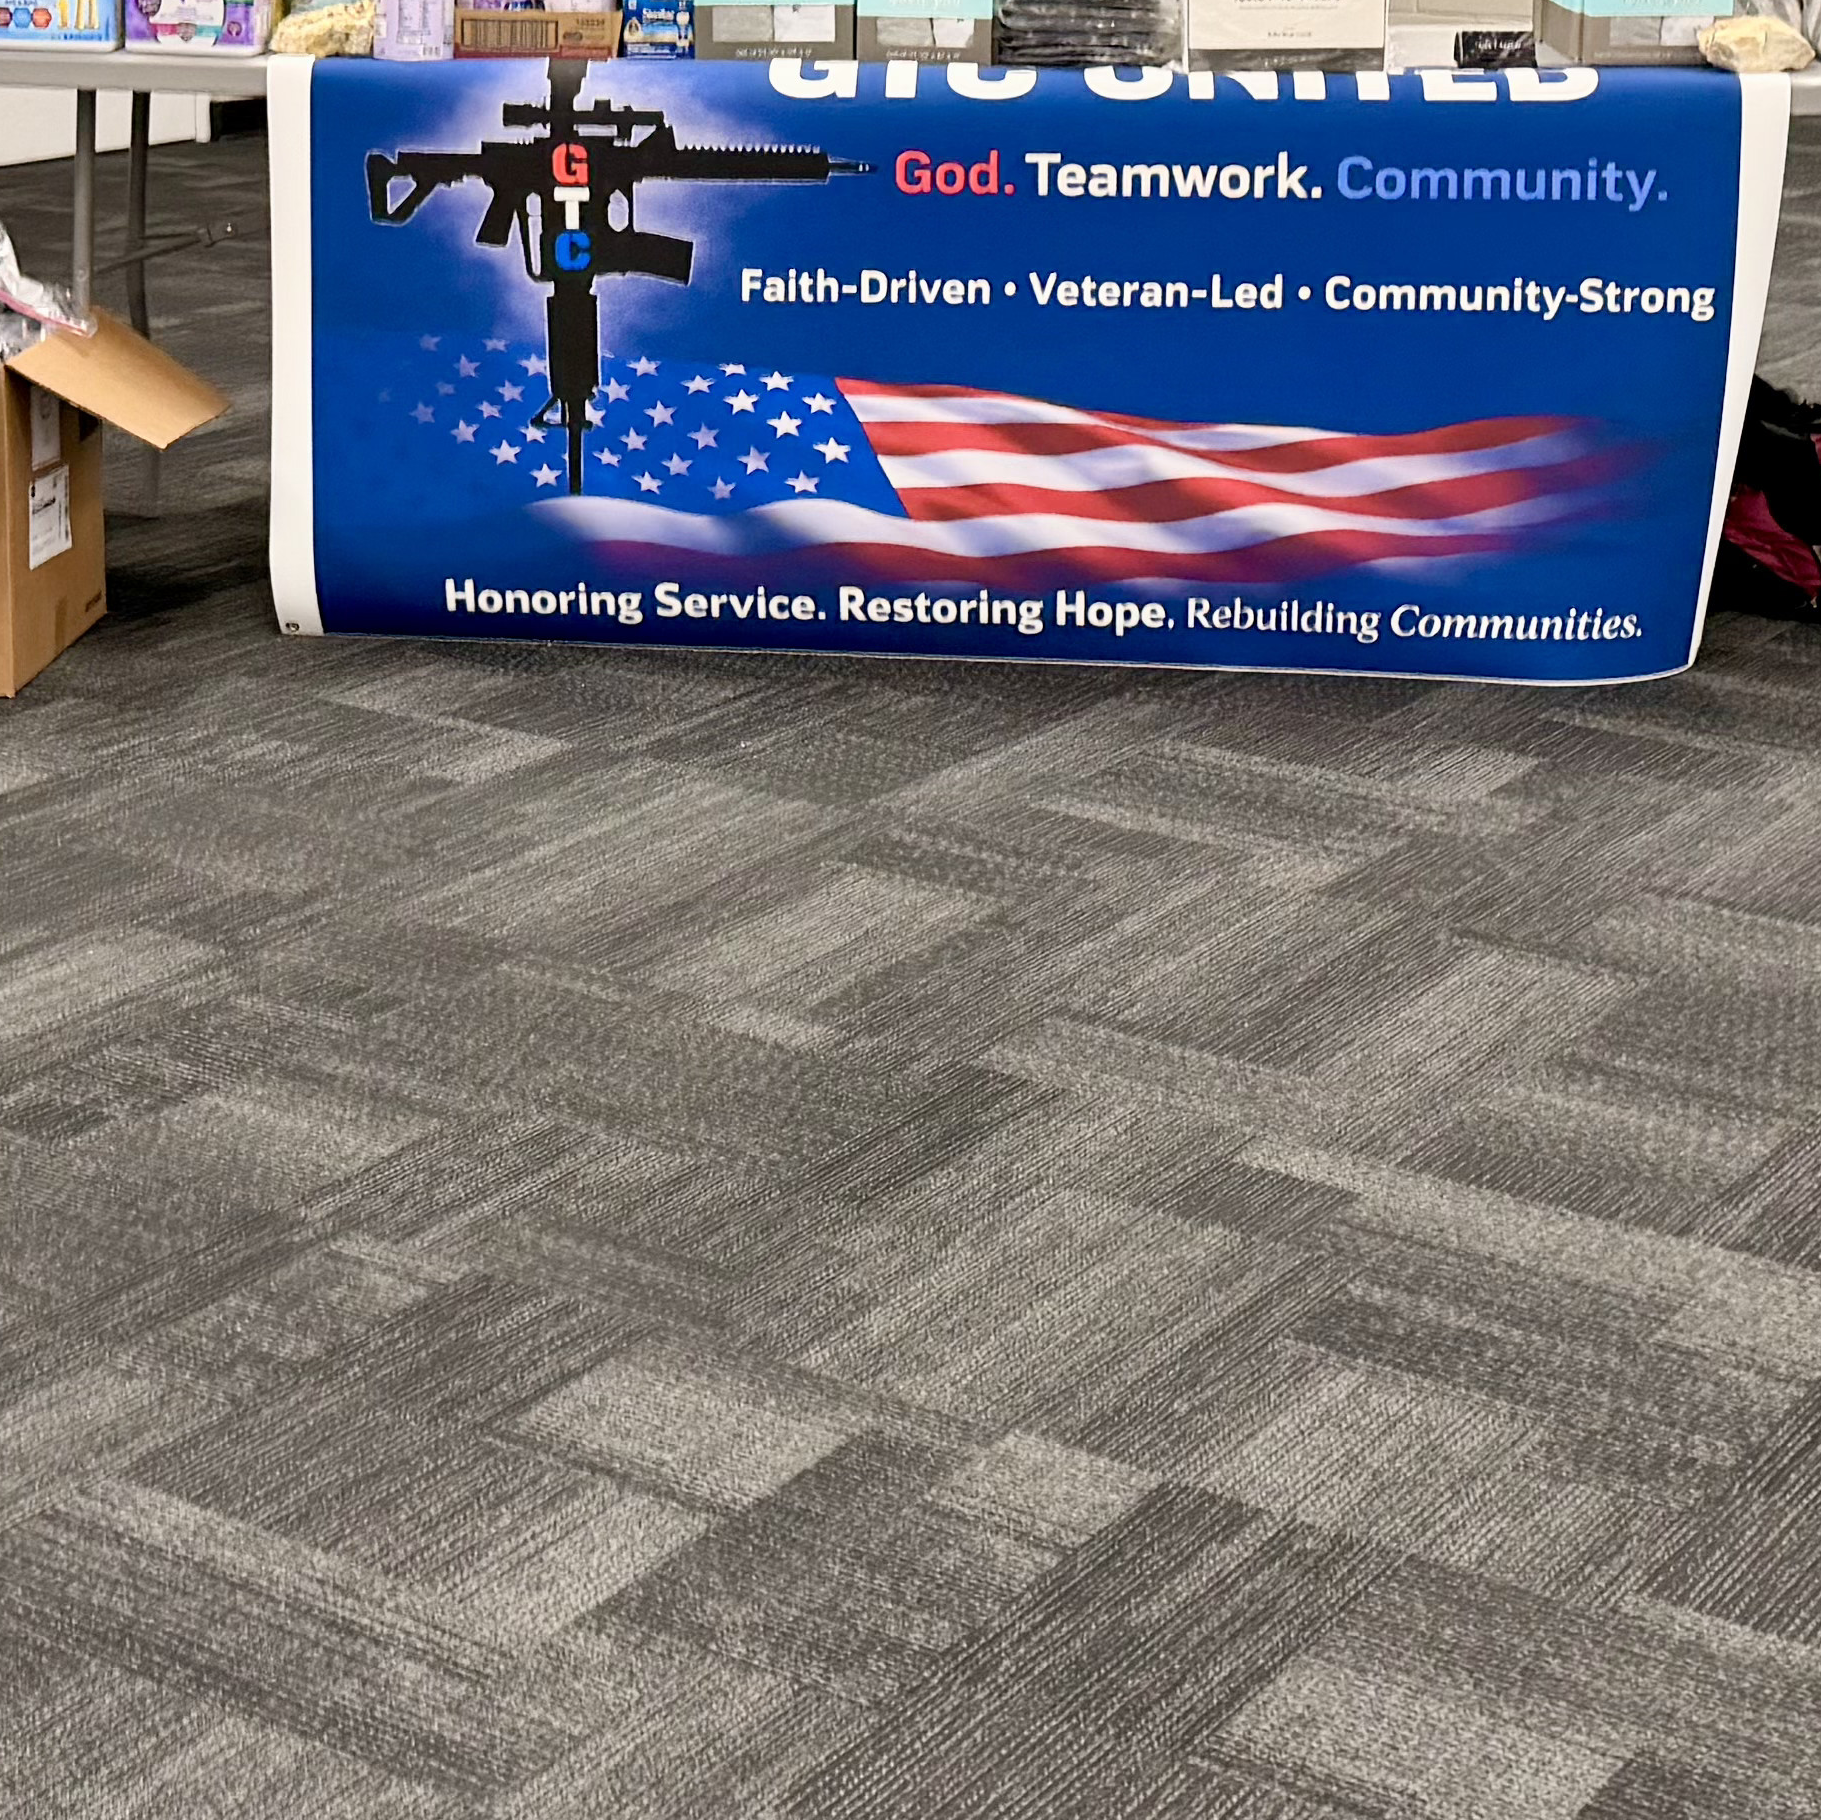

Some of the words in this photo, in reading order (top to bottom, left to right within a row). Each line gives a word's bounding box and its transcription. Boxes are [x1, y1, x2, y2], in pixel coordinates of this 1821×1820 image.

[896, 150, 1015, 196] God.
[1026, 152, 1323, 200] Teamwork.
[1337, 156, 1668, 212] Community.
[741, 267, 991, 305] Faith-Driven
[1028, 271, 1284, 310] Veteran-Led
[1325, 275, 1716, 322] Community-Strong
[445, 578, 643, 626] Honoring
[656, 584, 826, 623] Service.
[839, 585, 1044, 633] Restoring
[1056, 592, 1175, 637] Hope.
[1187, 598, 1381, 641] Rebuilding
[1390, 602, 1642, 643] Communities.
